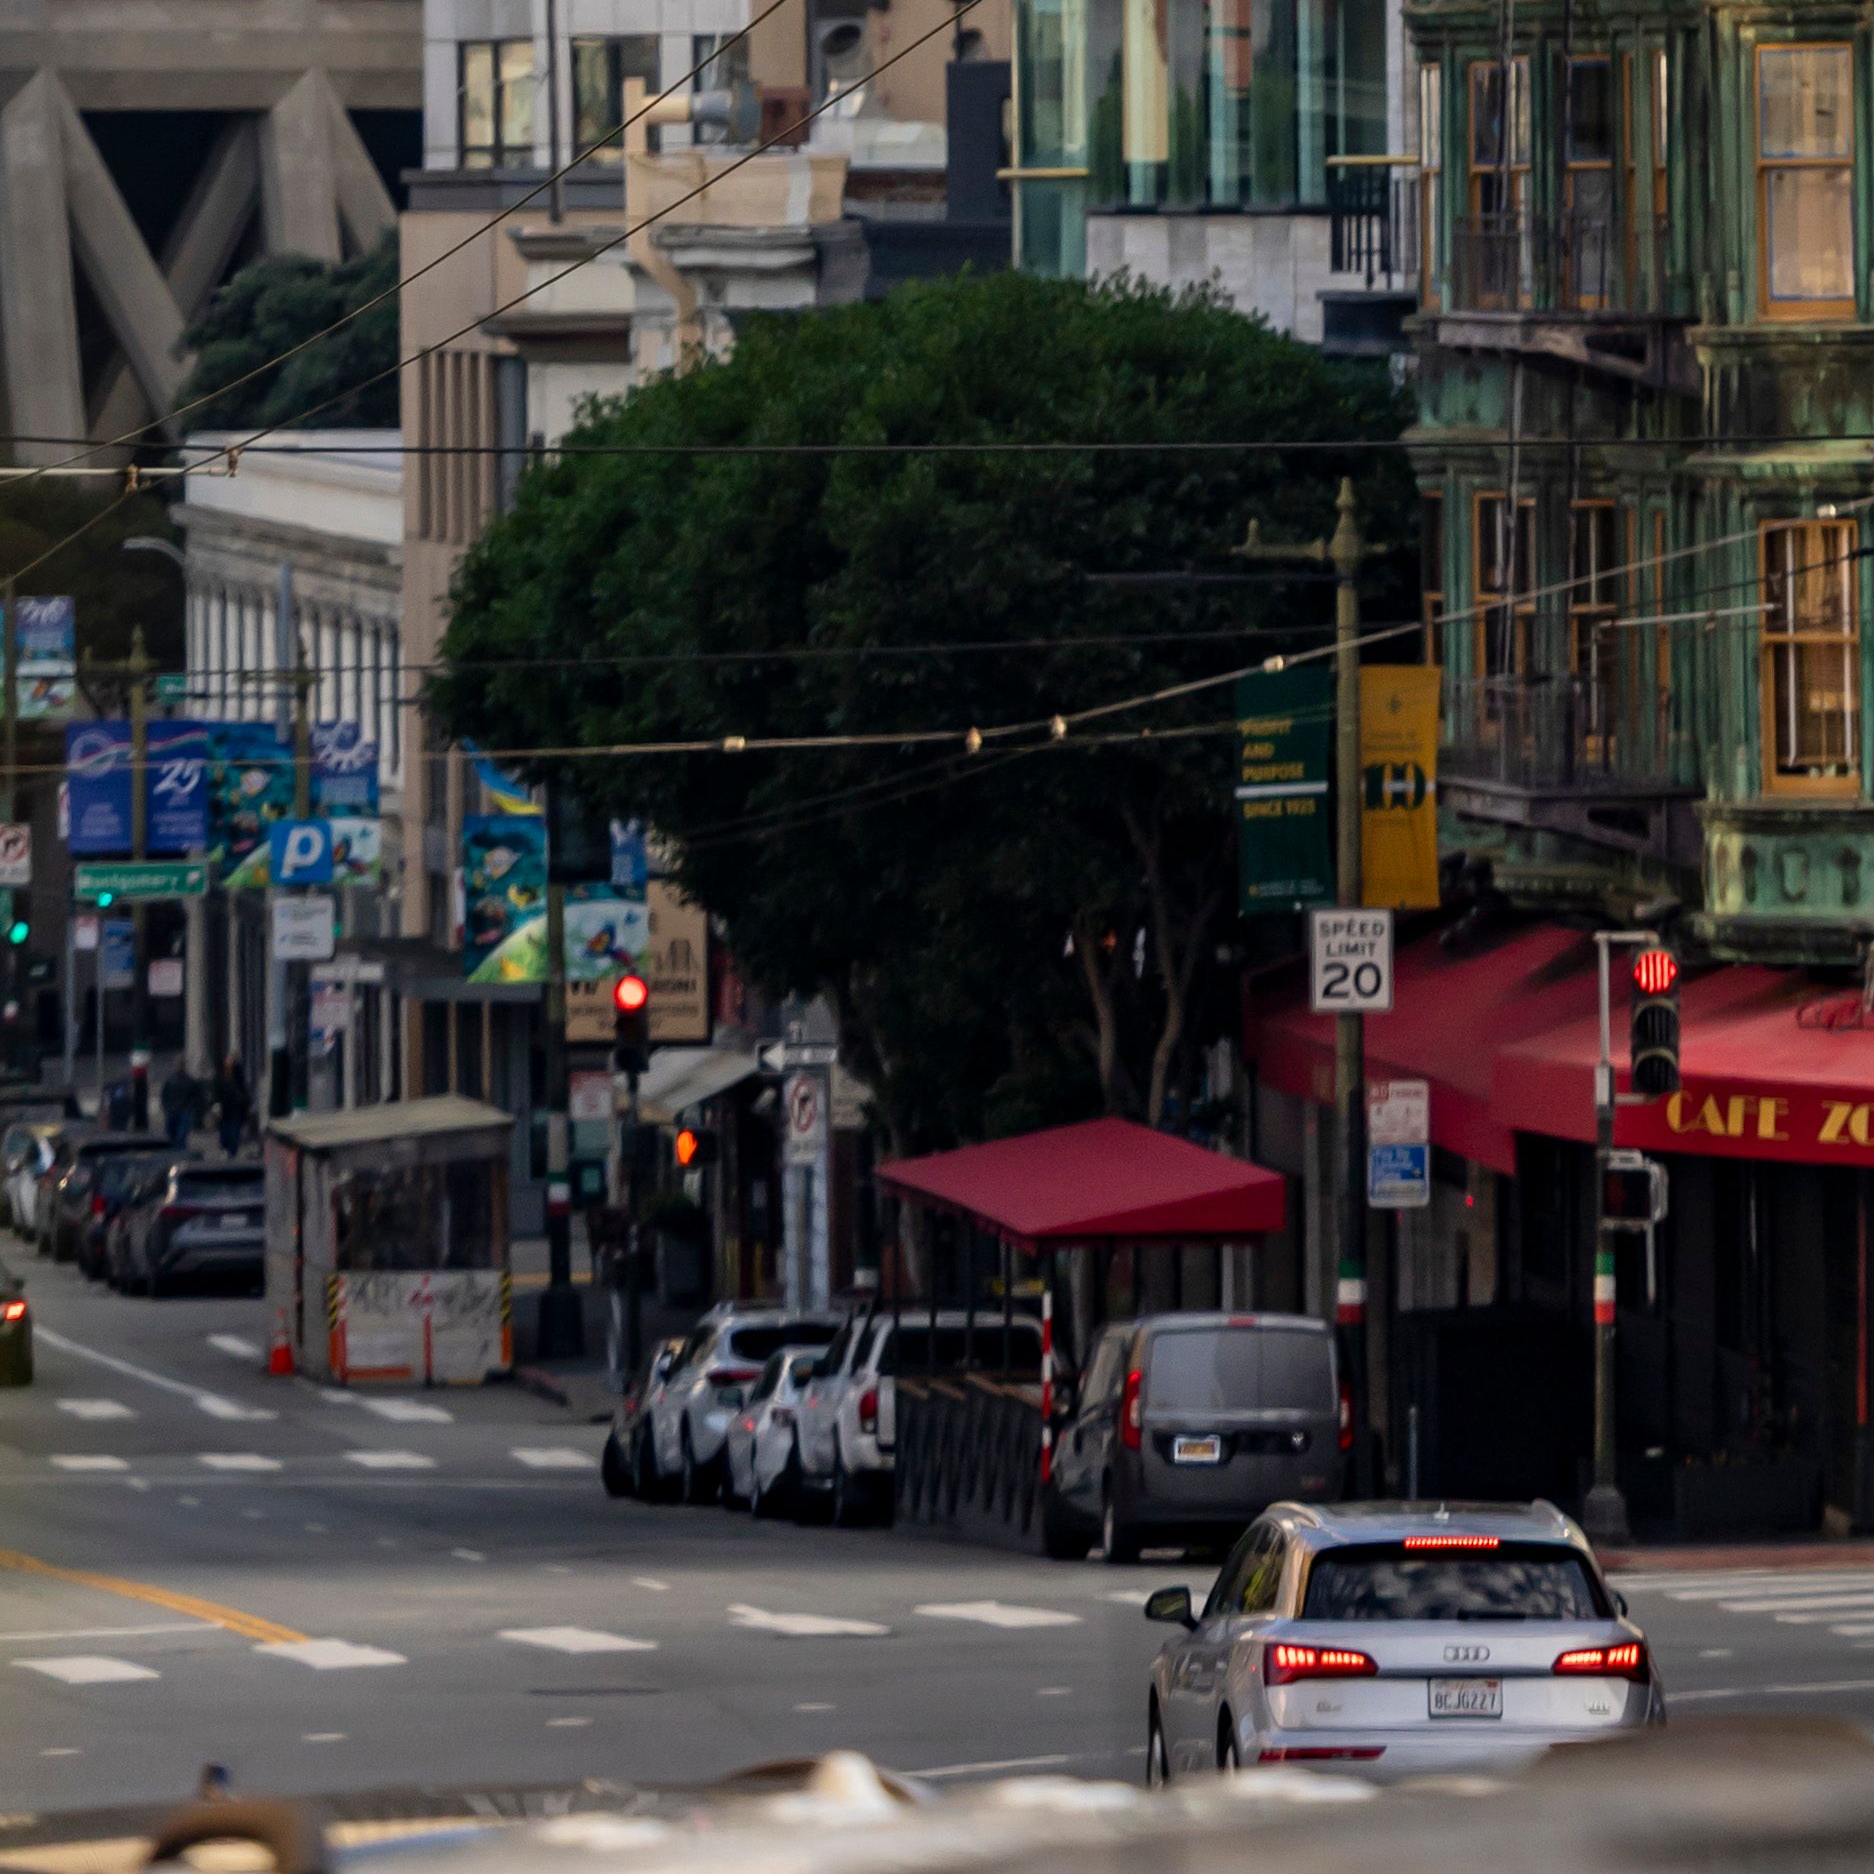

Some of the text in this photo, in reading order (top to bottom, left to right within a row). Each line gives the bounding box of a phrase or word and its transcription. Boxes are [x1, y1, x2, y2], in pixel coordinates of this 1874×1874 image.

[1319, 920, 1384, 937] SPEED
[1326, 942, 1376, 958] LIMIT
[1322, 962, 1382, 999] 20
[1666, 1090, 1790, 1141] CAFE
